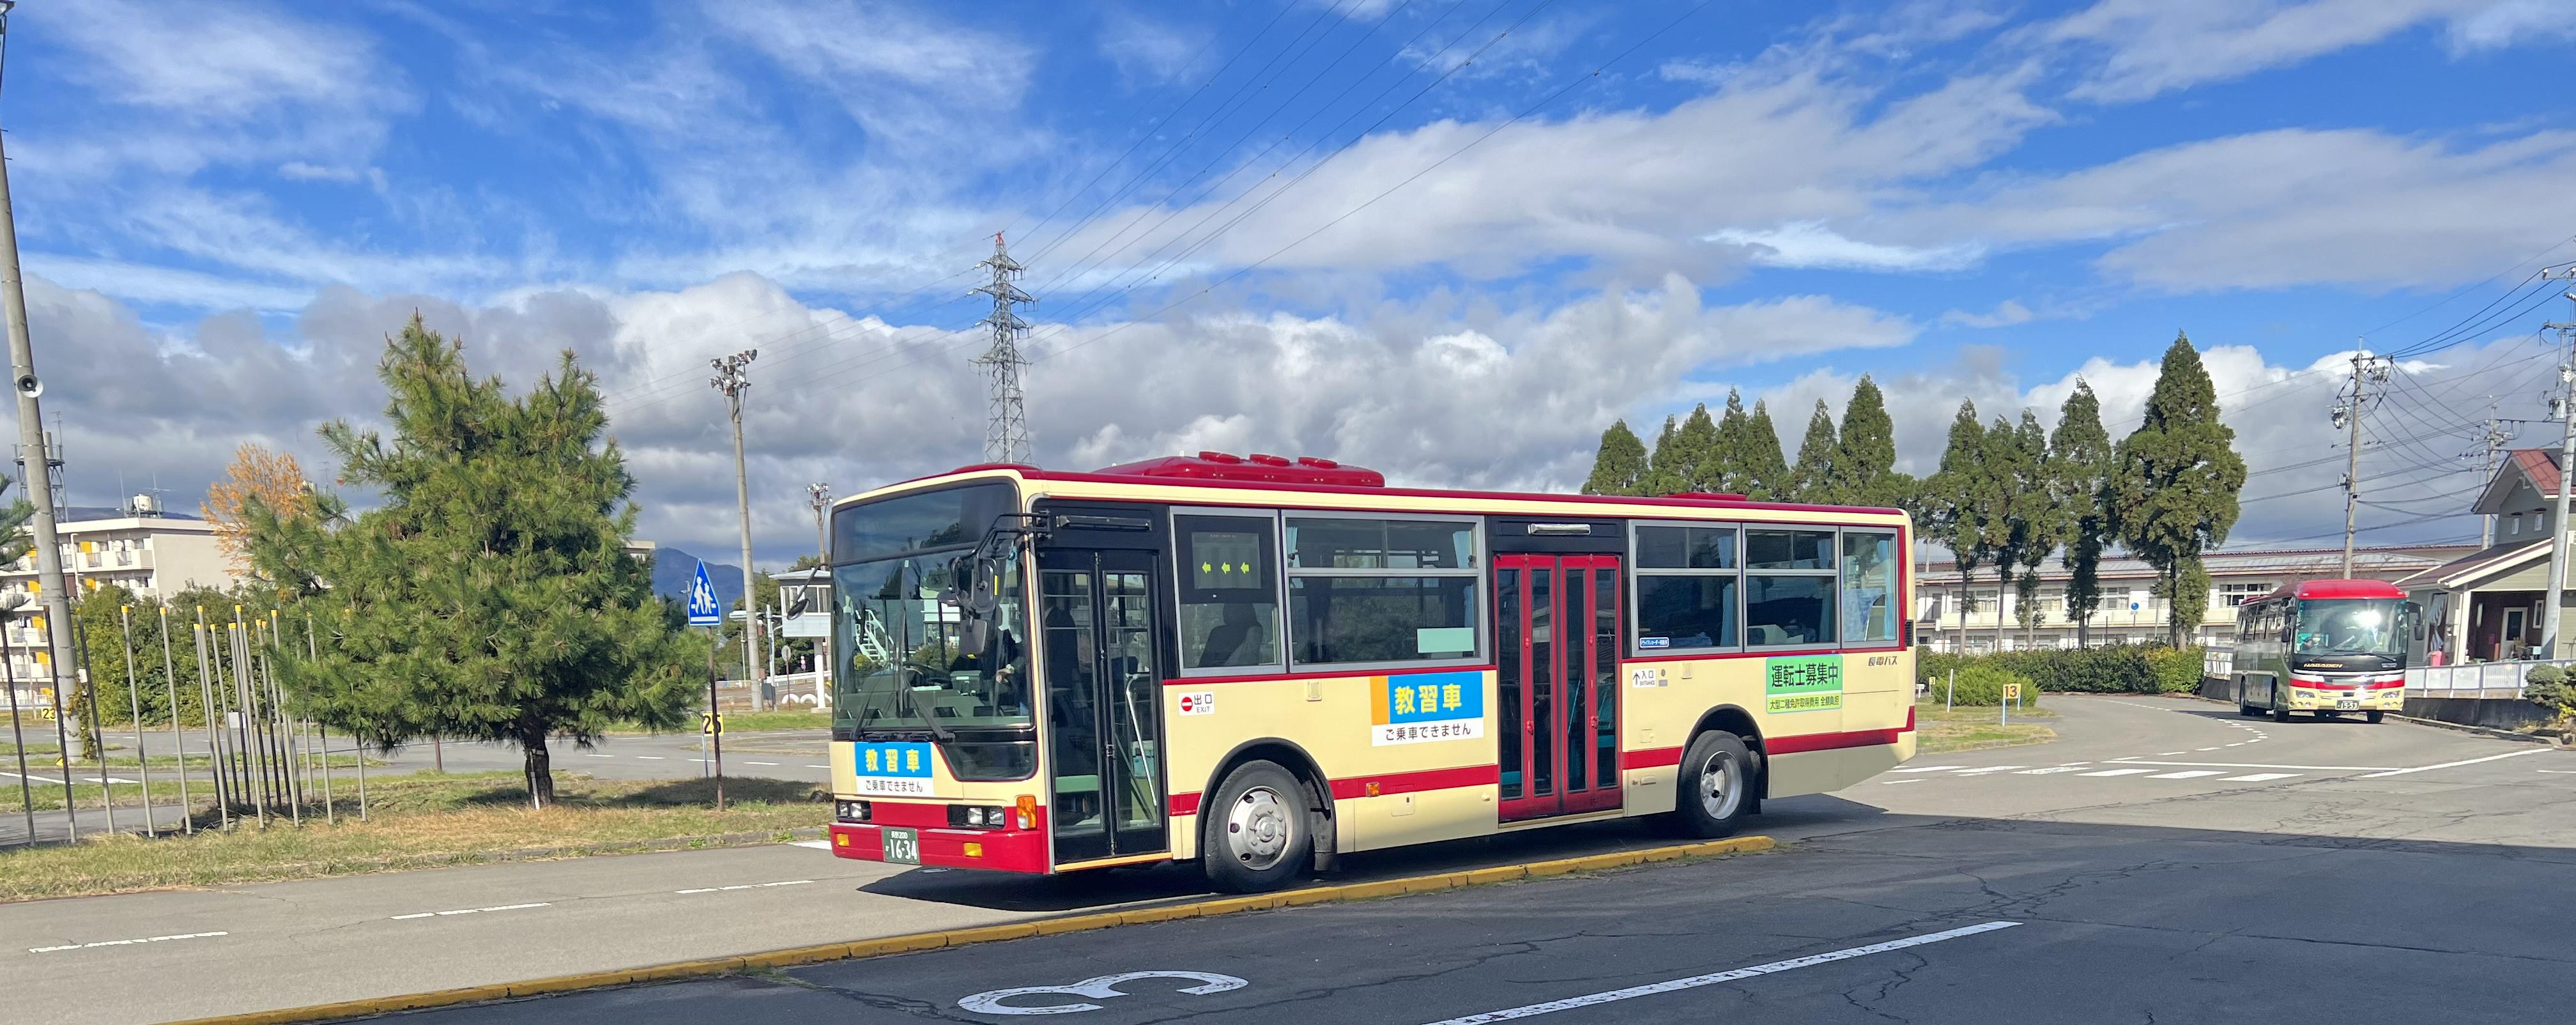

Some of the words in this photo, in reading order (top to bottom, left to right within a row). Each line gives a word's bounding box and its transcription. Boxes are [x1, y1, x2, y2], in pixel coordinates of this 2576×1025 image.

[1642, 670, 1653, 679] 入口
[1771, 662, 1838, 688] 運転士募集中
[1395, 684, 1462, 714] 教習車
[2004, 686, 2018, 697] 13
[1194, 694, 1212, 705] 出口
[42, 708, 56, 720] 23
[703, 714, 721, 734] 25
[1386, 723, 1471, 741] ご乗車できません
[865, 749, 920, 773] 教習車
[866, 780, 923, 792] ご乗車できません
